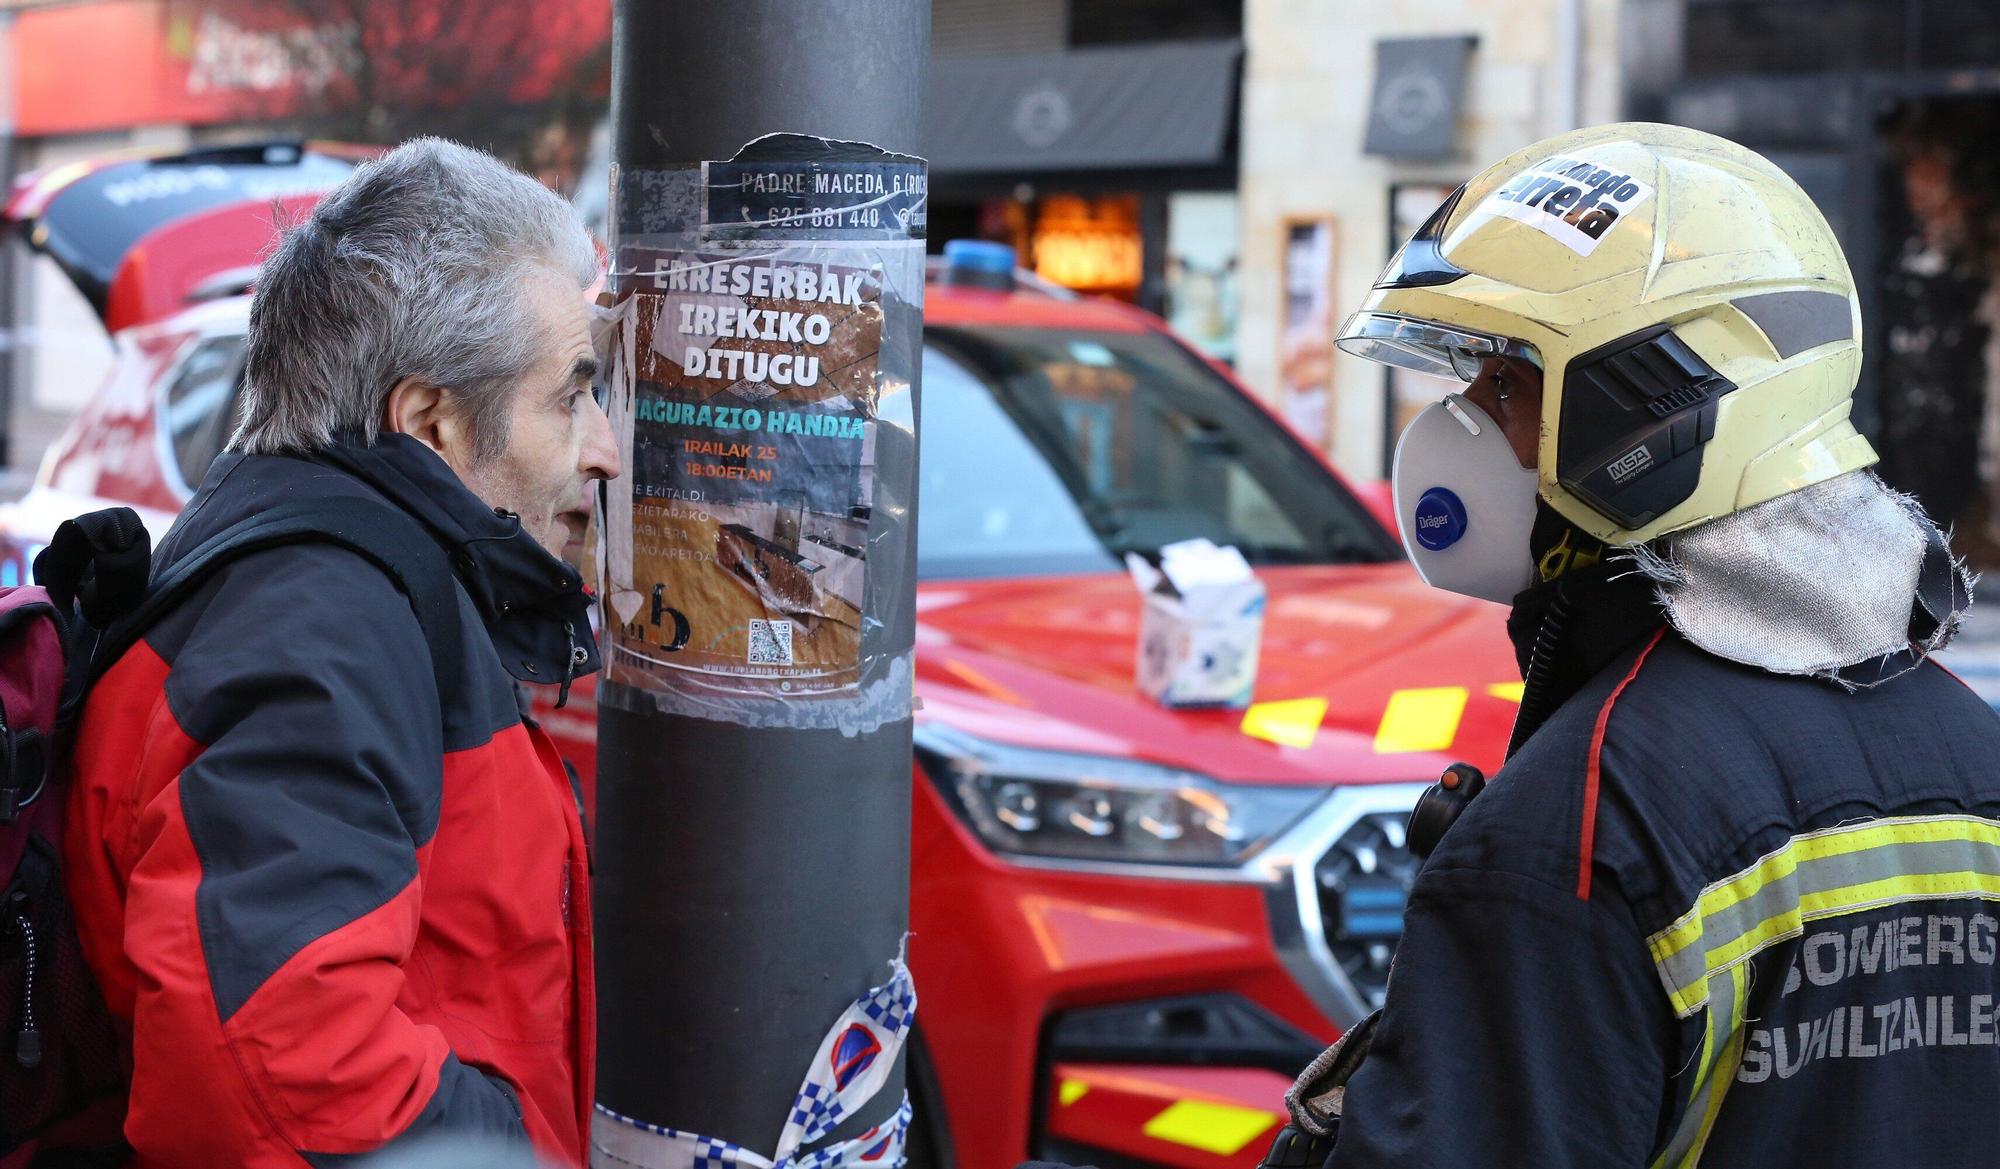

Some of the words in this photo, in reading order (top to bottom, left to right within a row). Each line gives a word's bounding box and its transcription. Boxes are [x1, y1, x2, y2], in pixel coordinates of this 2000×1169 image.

[741, 172, 806, 194] PADRE
[815, 172, 888, 196] MACEDA,
[893, 174, 901, 194] 6
[1532, 156, 1640, 202] uemado
[768, 207, 803, 228] 625
[850, 208, 878, 228] 440
[1498, 174, 1620, 241] erreta
[654, 257, 863, 306] ERRESERBAK
[678, 303, 831, 346] IREKIKO
[684, 346, 819, 388] DITUGU
[766, 410, 865, 440] HANDIA
[684, 439, 752, 459] IRAILAK
[757, 446, 777, 460] 25
[1609, 448, 1650, 480] MSA
[686, 462, 772, 482] 18:00ETAN
[646, 485, 705, 502] EKITALDI
[1418, 514, 1448, 529] Dräger
